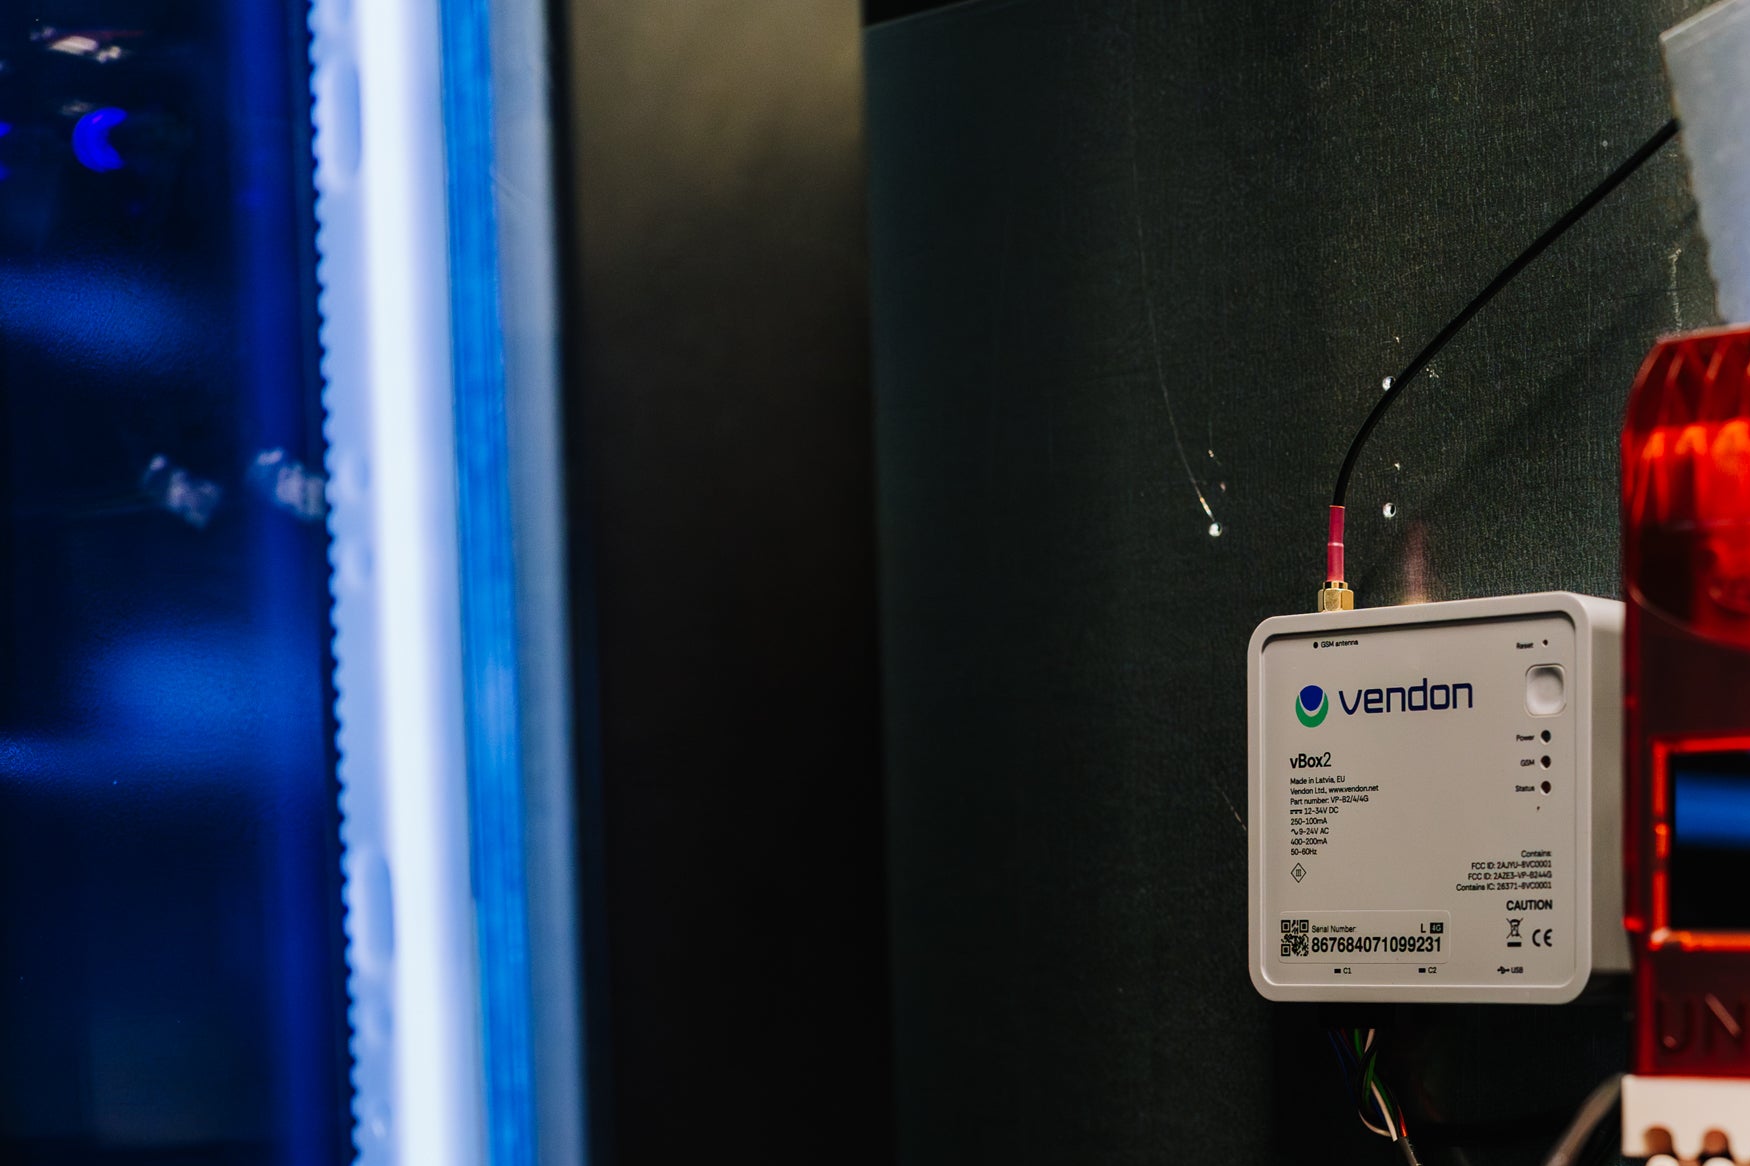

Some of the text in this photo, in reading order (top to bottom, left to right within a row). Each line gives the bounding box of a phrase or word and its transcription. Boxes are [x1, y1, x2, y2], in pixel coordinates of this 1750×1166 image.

[1320, 639, 1359, 648] GSM antenna
[1339, 678, 1473, 715] vendon
[1290, 752, 1332, 769] vBox2
[1290, 777, 1307, 785] Made
[1315, 776, 1335, 784] Latvia,
[1336, 775, 1345, 783] EU
[1290, 787, 1313, 795] Vendon
[1328, 784, 1379, 793] www.vendon.net
[1515, 784, 1535, 792] Status
[1290, 797, 1303, 805] Part
[1304, 796, 1330, 805] number:
[1304, 806, 1339, 815] 12-34V DC
[1290, 817, 1328, 826] 250-100mA
[1319, 827, 1330, 835] AC
[1290, 837, 1328, 846] 400-200mA
[1290, 847, 1318, 856] 50-60Hz
[1471, 861, 1486, 870] FCC
[1487, 861, 1496, 869] ID:
[1468, 872, 1483, 881] FCC
[1484, 872, 1492, 880] ID:
[1456, 883, 1486, 892] Contains
[1506, 899, 1553, 911] CAUTION
[1312, 924, 1330, 934] Serial
[1421, 923, 1427, 934] L
[1431, 924, 1443, 932] 4G
[1311, 936, 1442, 953] 867684071099231
[1343, 967, 1352, 975] C1
[1428, 966, 1437, 974] C2
[1511, 966, 1524, 974] USB
